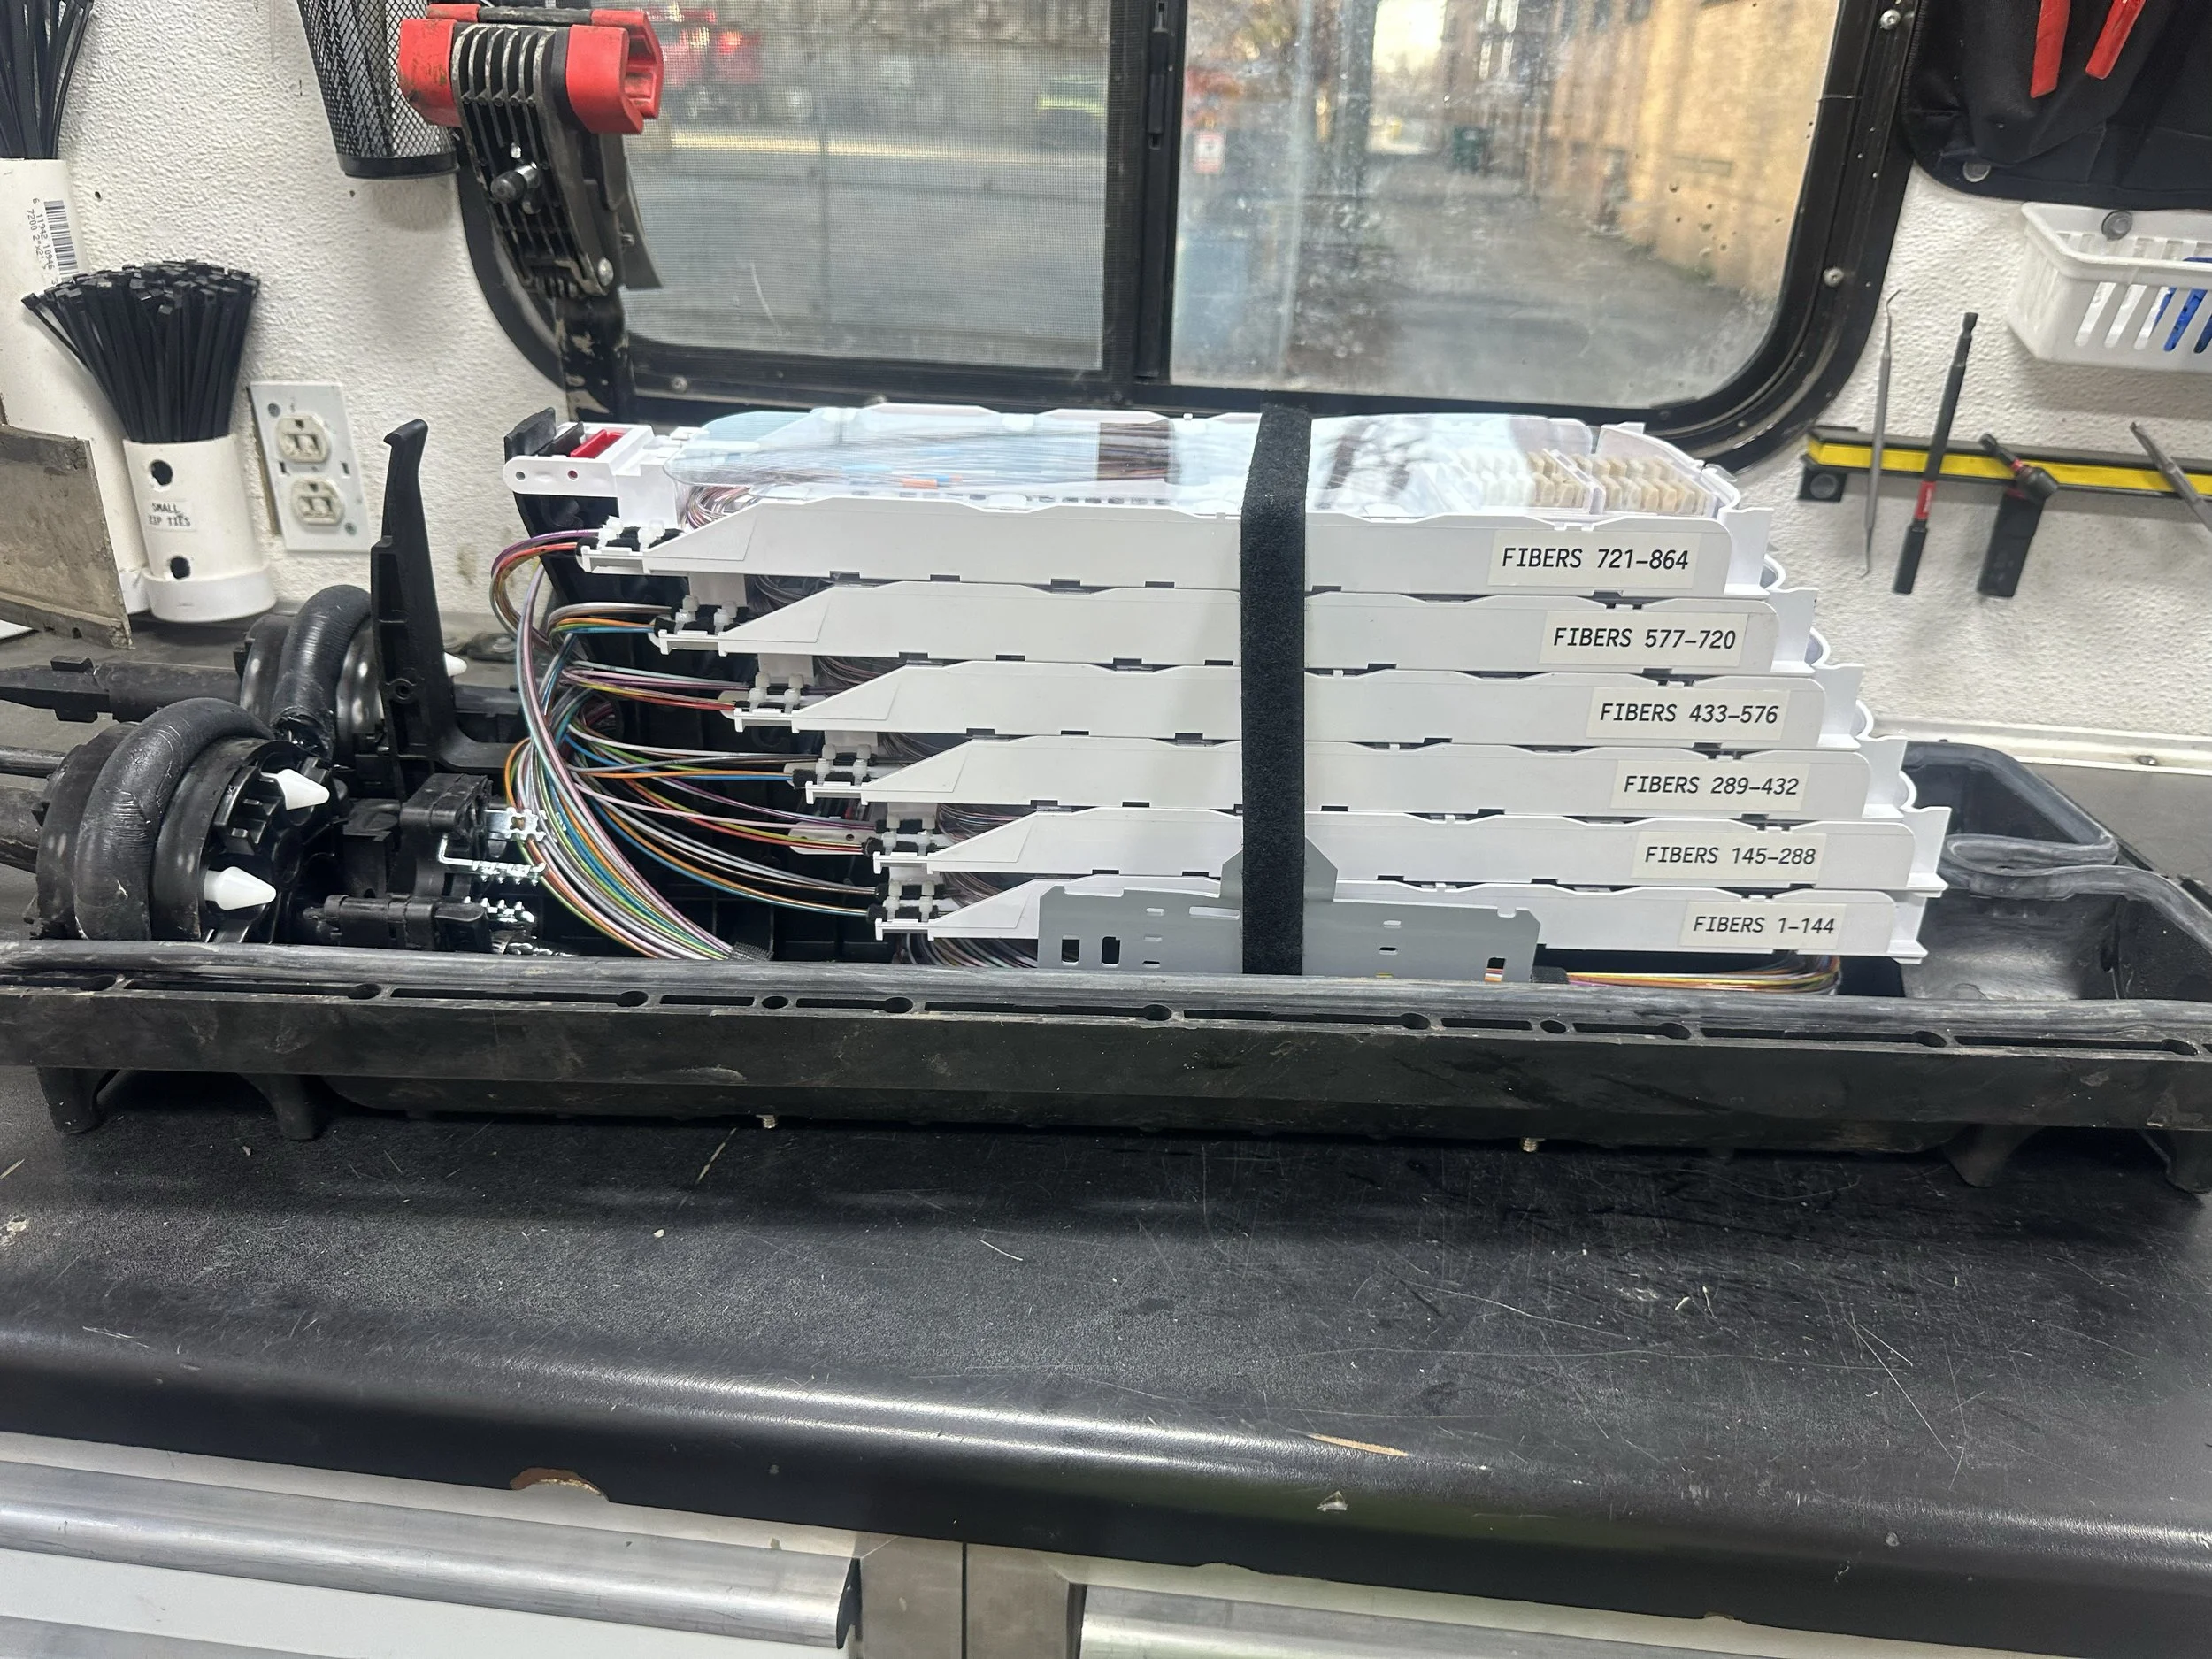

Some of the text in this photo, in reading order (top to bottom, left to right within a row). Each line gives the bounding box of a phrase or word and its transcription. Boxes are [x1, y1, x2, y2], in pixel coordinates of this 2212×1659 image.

[27, 209, 38, 231] 7200
[36, 213, 48, 240] 11942
[151, 503, 181, 513] SMALL
[149, 515, 191, 527] ZIP TIES
[1502, 547, 1689, 570] FIBERS 721-864
[1553, 627, 1736, 649] FIBERS 577-720
[1600, 703, 1779, 724] FIBERS 433-576
[1624, 775, 1800, 795] FIBERS 289-432
[1645, 846, 1816, 865] FIBERS 145-288
[1693, 916, 1835, 934] FIBERS 1-144
